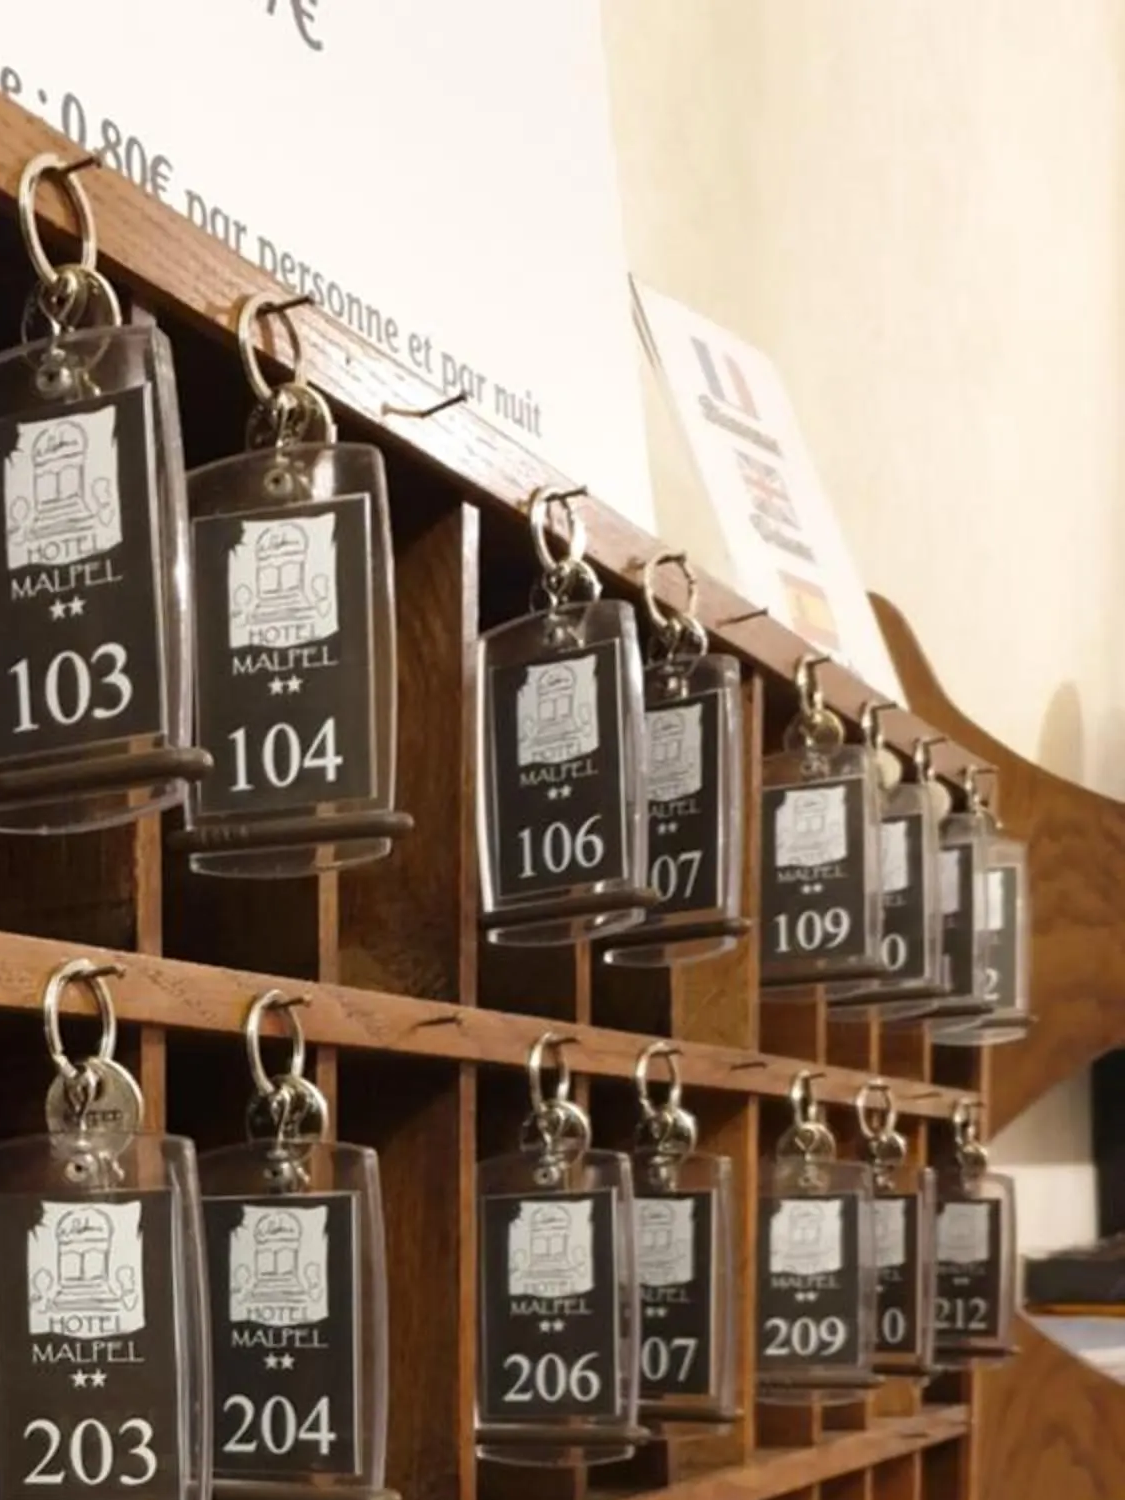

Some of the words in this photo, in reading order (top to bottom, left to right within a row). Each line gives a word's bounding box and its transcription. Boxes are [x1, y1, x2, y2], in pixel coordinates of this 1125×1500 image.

[408, 332, 433, 375] et
[441, 351, 487, 404] par
[494, 381, 542, 438] nuit
[26, 533, 101, 563] HOTEL
[11, 559, 124, 600] MALPEL
[231, 645, 340, 676] MALPEL
[7, 641, 133, 733] 103
[227, 716, 344, 792] 104
[517, 814, 605, 879] 106
[650, 850, 703, 901] 07
[773, 906, 851, 953] 109
[49, 1314, 122, 1334] HOTEL
[762, 1315, 847, 1357] 209
[933, 1296, 988, 1330] 212
[31, 1340, 146, 1364] MALPEL
[230, 1327, 330, 1348] MALPEL
[641, 1336, 699, 1383] 07
[502, 1351, 602, 1403] 206
[222, 1393, 338, 1456] 204
[22, 1417, 158, 1486] 203
